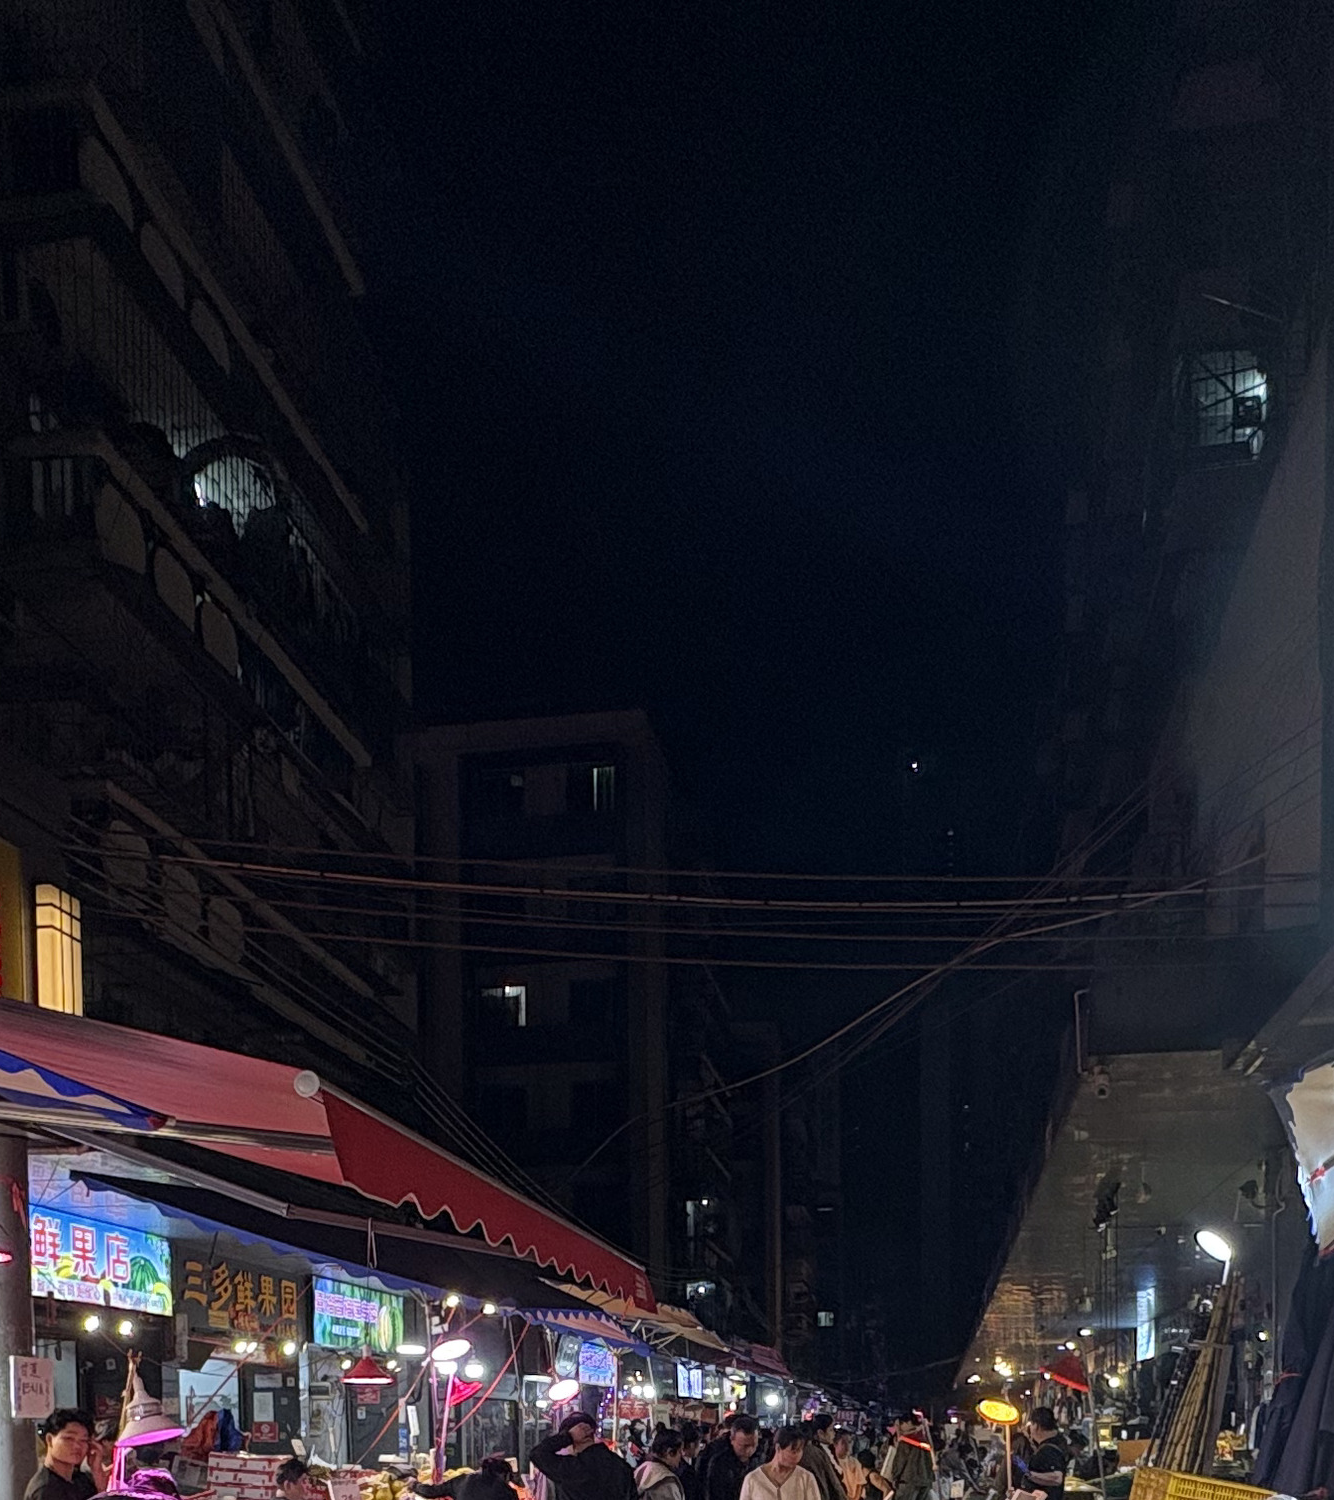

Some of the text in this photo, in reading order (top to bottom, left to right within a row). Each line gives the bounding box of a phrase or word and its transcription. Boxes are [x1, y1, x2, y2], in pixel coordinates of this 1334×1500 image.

[183, 1261, 298, 1320] 三多鲜果园
